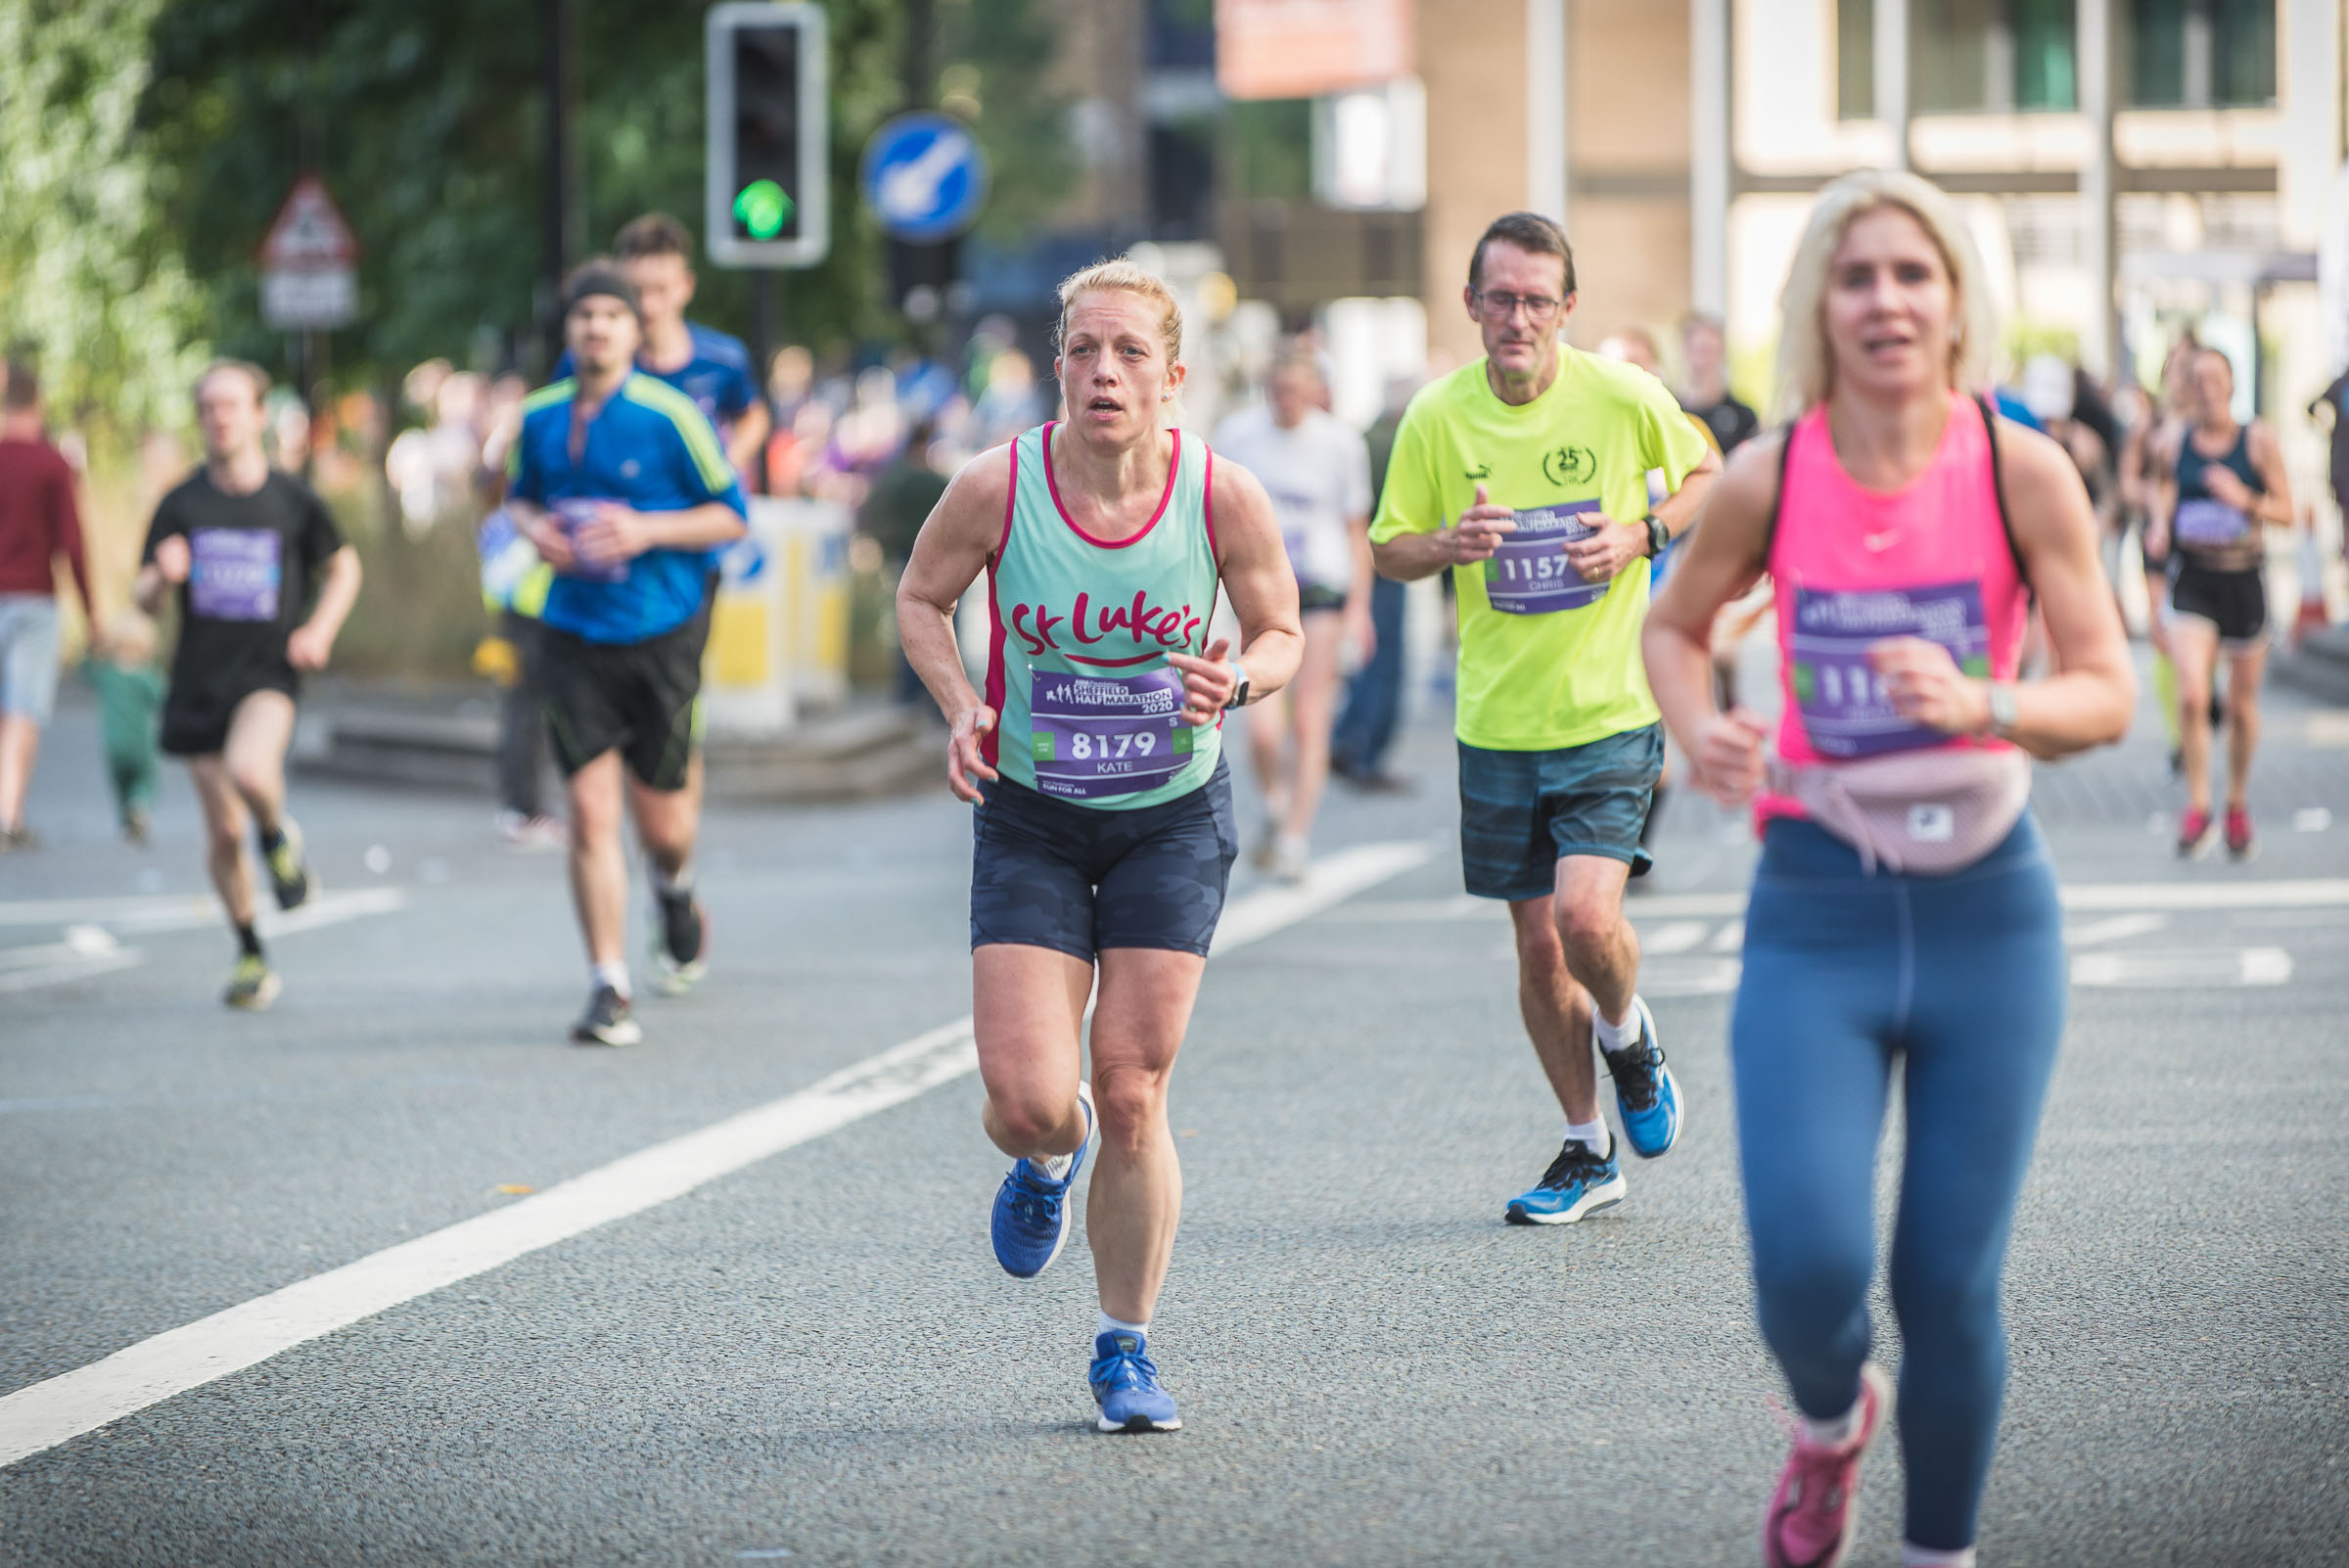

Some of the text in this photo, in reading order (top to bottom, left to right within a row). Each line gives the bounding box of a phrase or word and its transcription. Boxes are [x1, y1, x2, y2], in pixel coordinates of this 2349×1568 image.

[1072, 589, 1200, 649] Luke's
[1075, 685, 1128, 696] SHEFFIELD
[1077, 688, 1172, 705] HALF MARATHON
[1142, 701, 1174, 714] 2020
[1072, 731, 1156, 760] 8179
[1096, 761, 1133, 774] KATE
